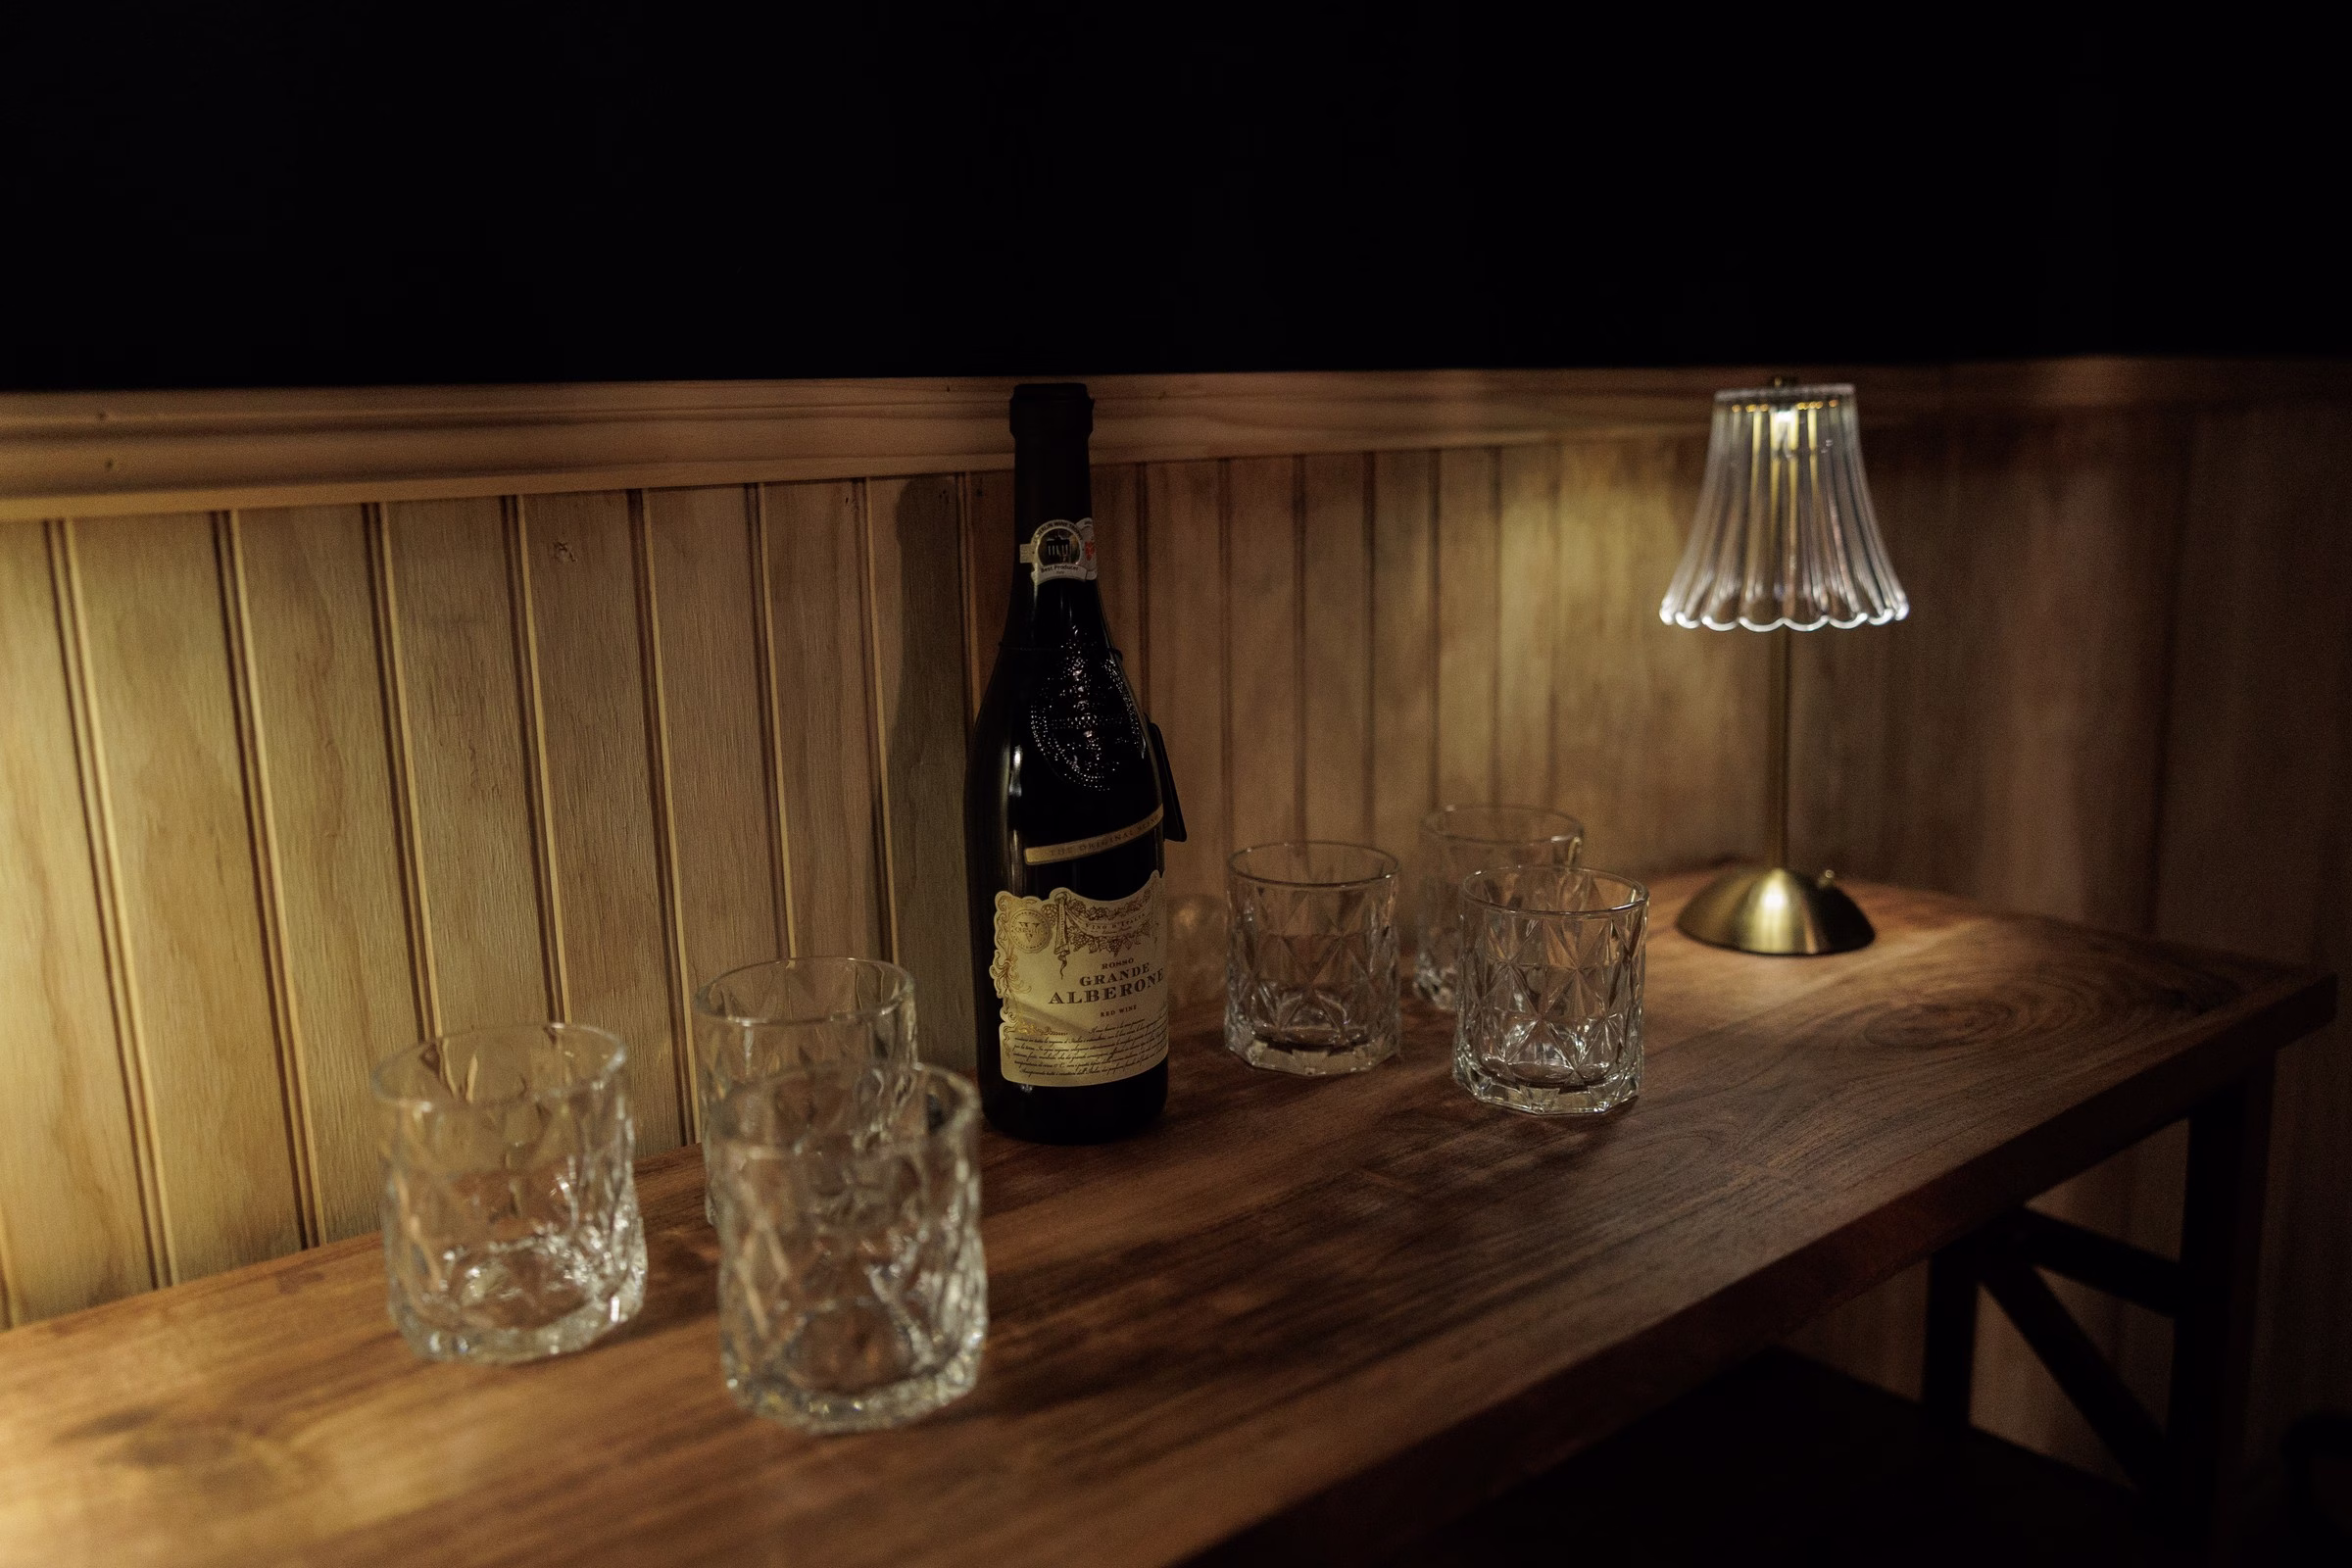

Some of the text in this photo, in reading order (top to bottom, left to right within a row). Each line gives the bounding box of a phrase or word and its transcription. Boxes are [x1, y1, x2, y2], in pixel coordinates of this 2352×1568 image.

[1102, 957, 1135, 970] ROSSO
[1079, 962, 1150, 987] GRANDE
[1048, 967, 1164, 1004] ALBERONE
[1119, 1004, 1137, 1013] WINE
